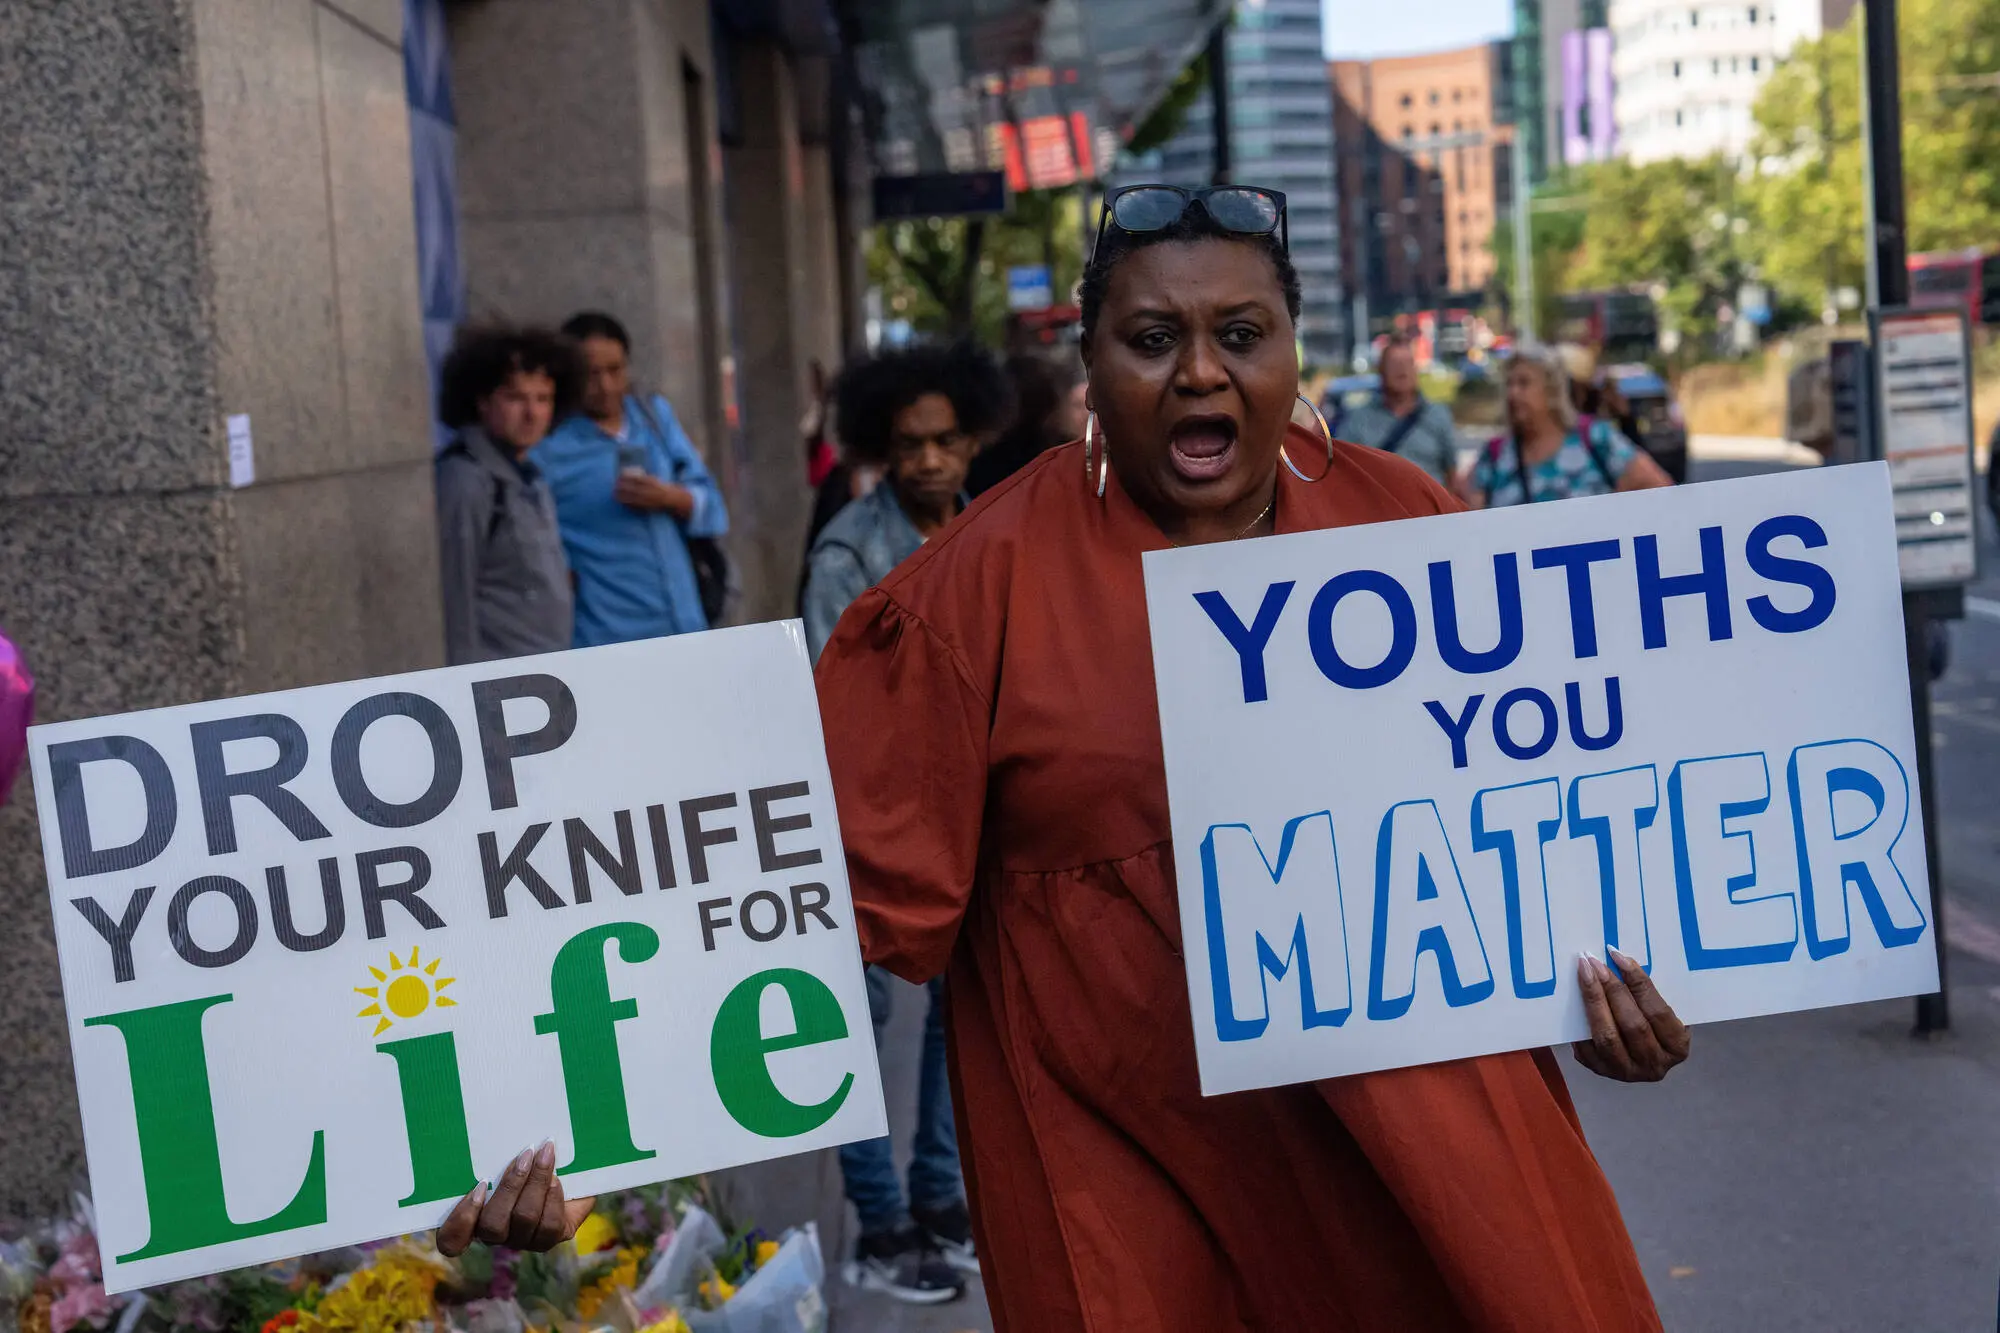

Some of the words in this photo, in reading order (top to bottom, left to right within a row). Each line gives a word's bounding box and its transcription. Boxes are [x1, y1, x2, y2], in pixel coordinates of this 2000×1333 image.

[1192, 515, 1838, 703] YOUTHS
[46, 673, 578, 879] DROP
[1422, 676, 1624, 769] YOU
[70, 845, 447, 983] YOUR
[478, 780, 823, 919] KNIFE
[697, 881, 839, 951] FOR
[1201, 738, 1927, 1042] MATTER
[83, 921, 855, 1264] Life
